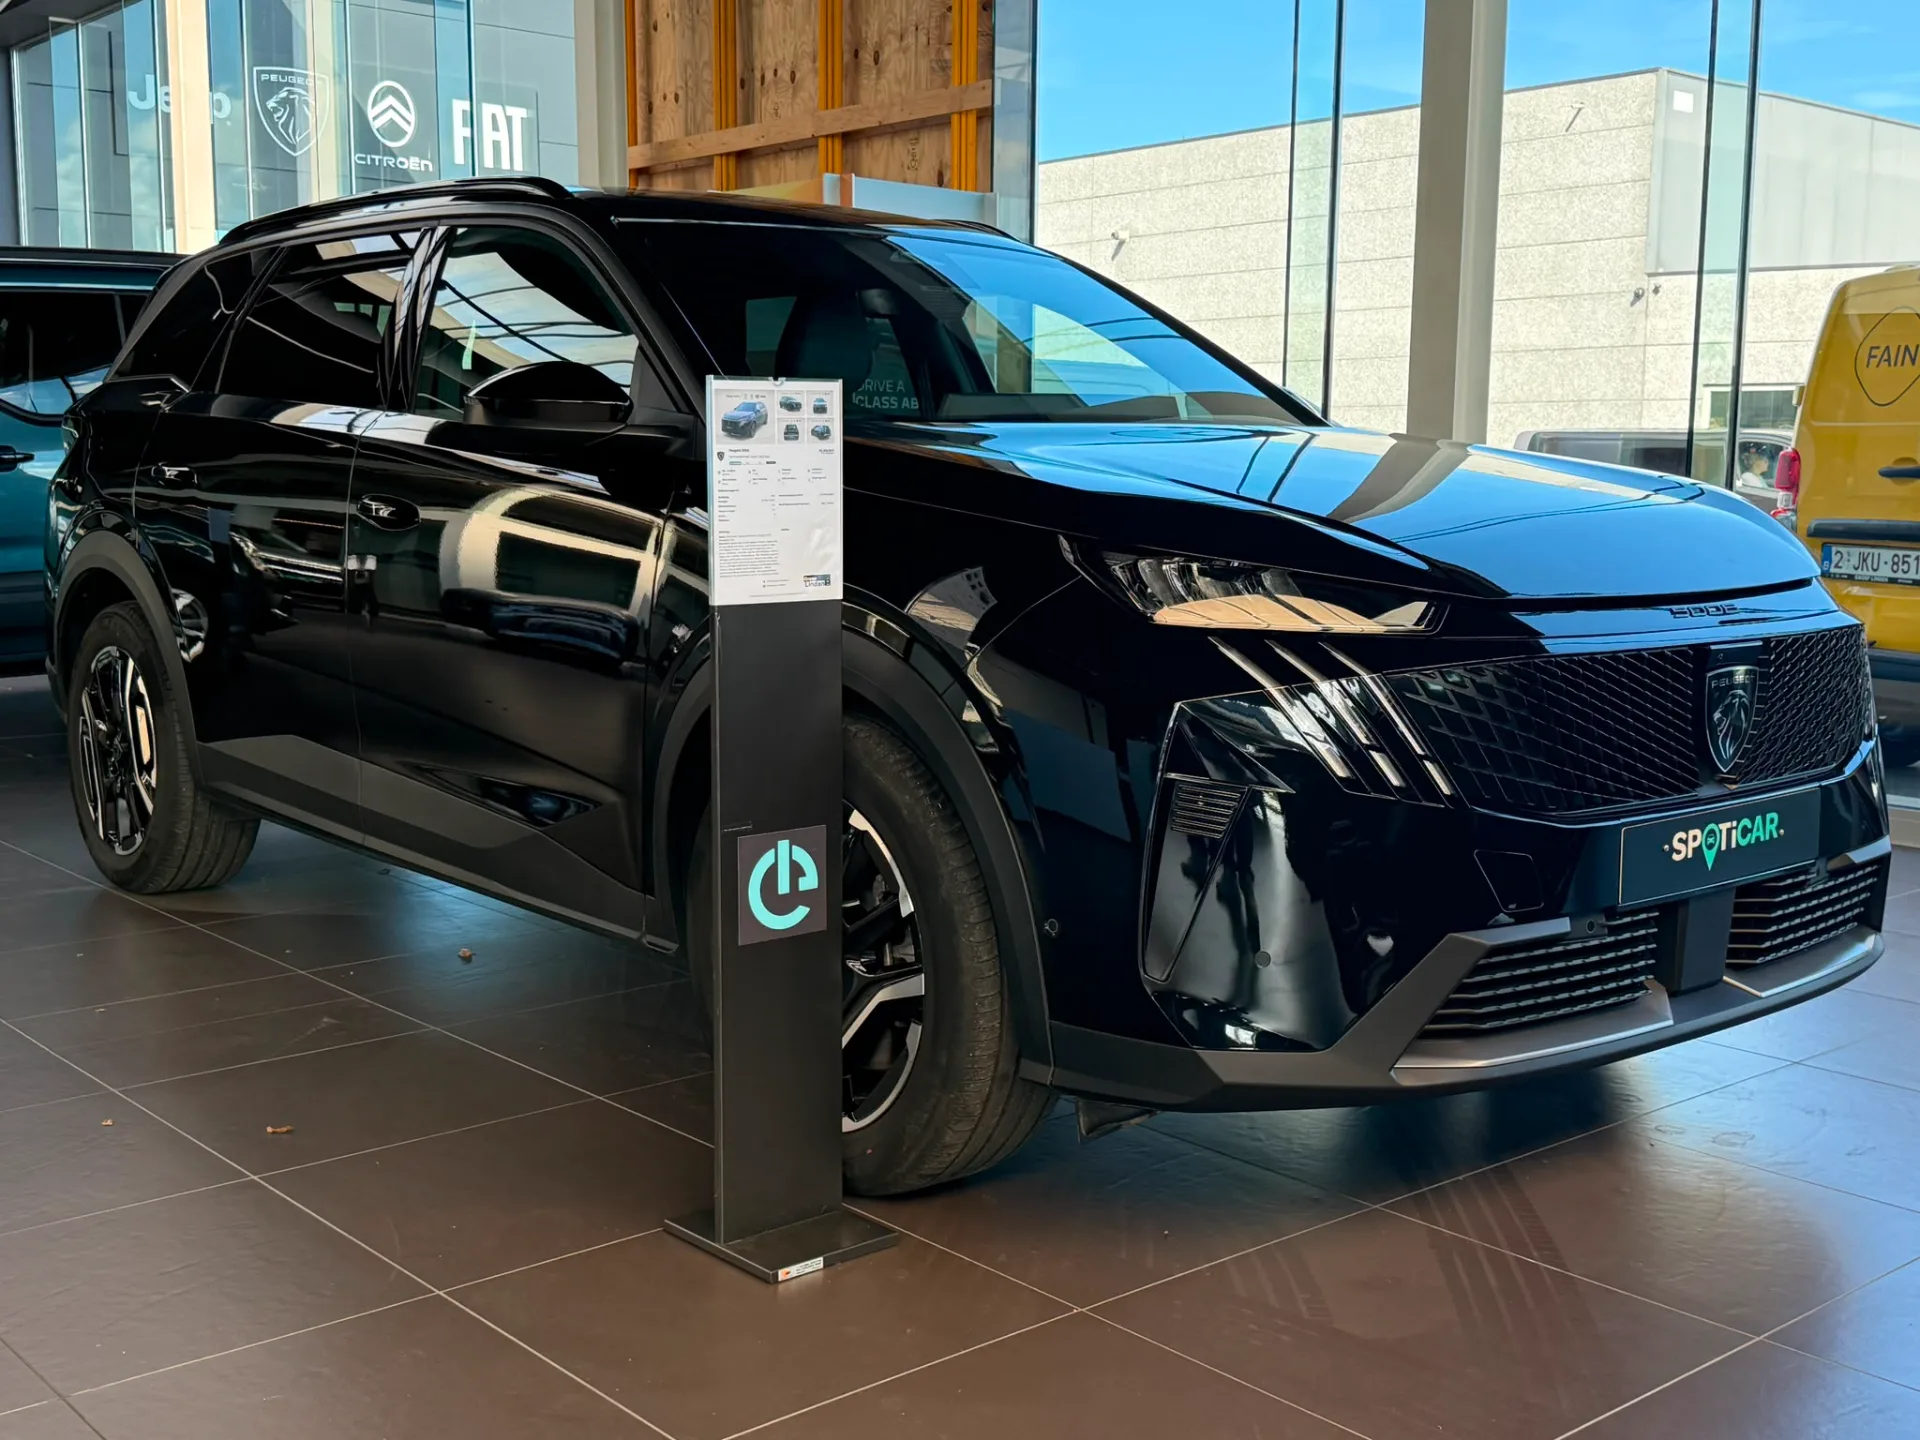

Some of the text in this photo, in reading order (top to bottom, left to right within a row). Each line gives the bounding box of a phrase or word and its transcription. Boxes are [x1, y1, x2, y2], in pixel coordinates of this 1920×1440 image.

[128, 74, 232, 125] Jep
[452, 98, 528, 171] FAT
[896, 381, 905, 393] A
